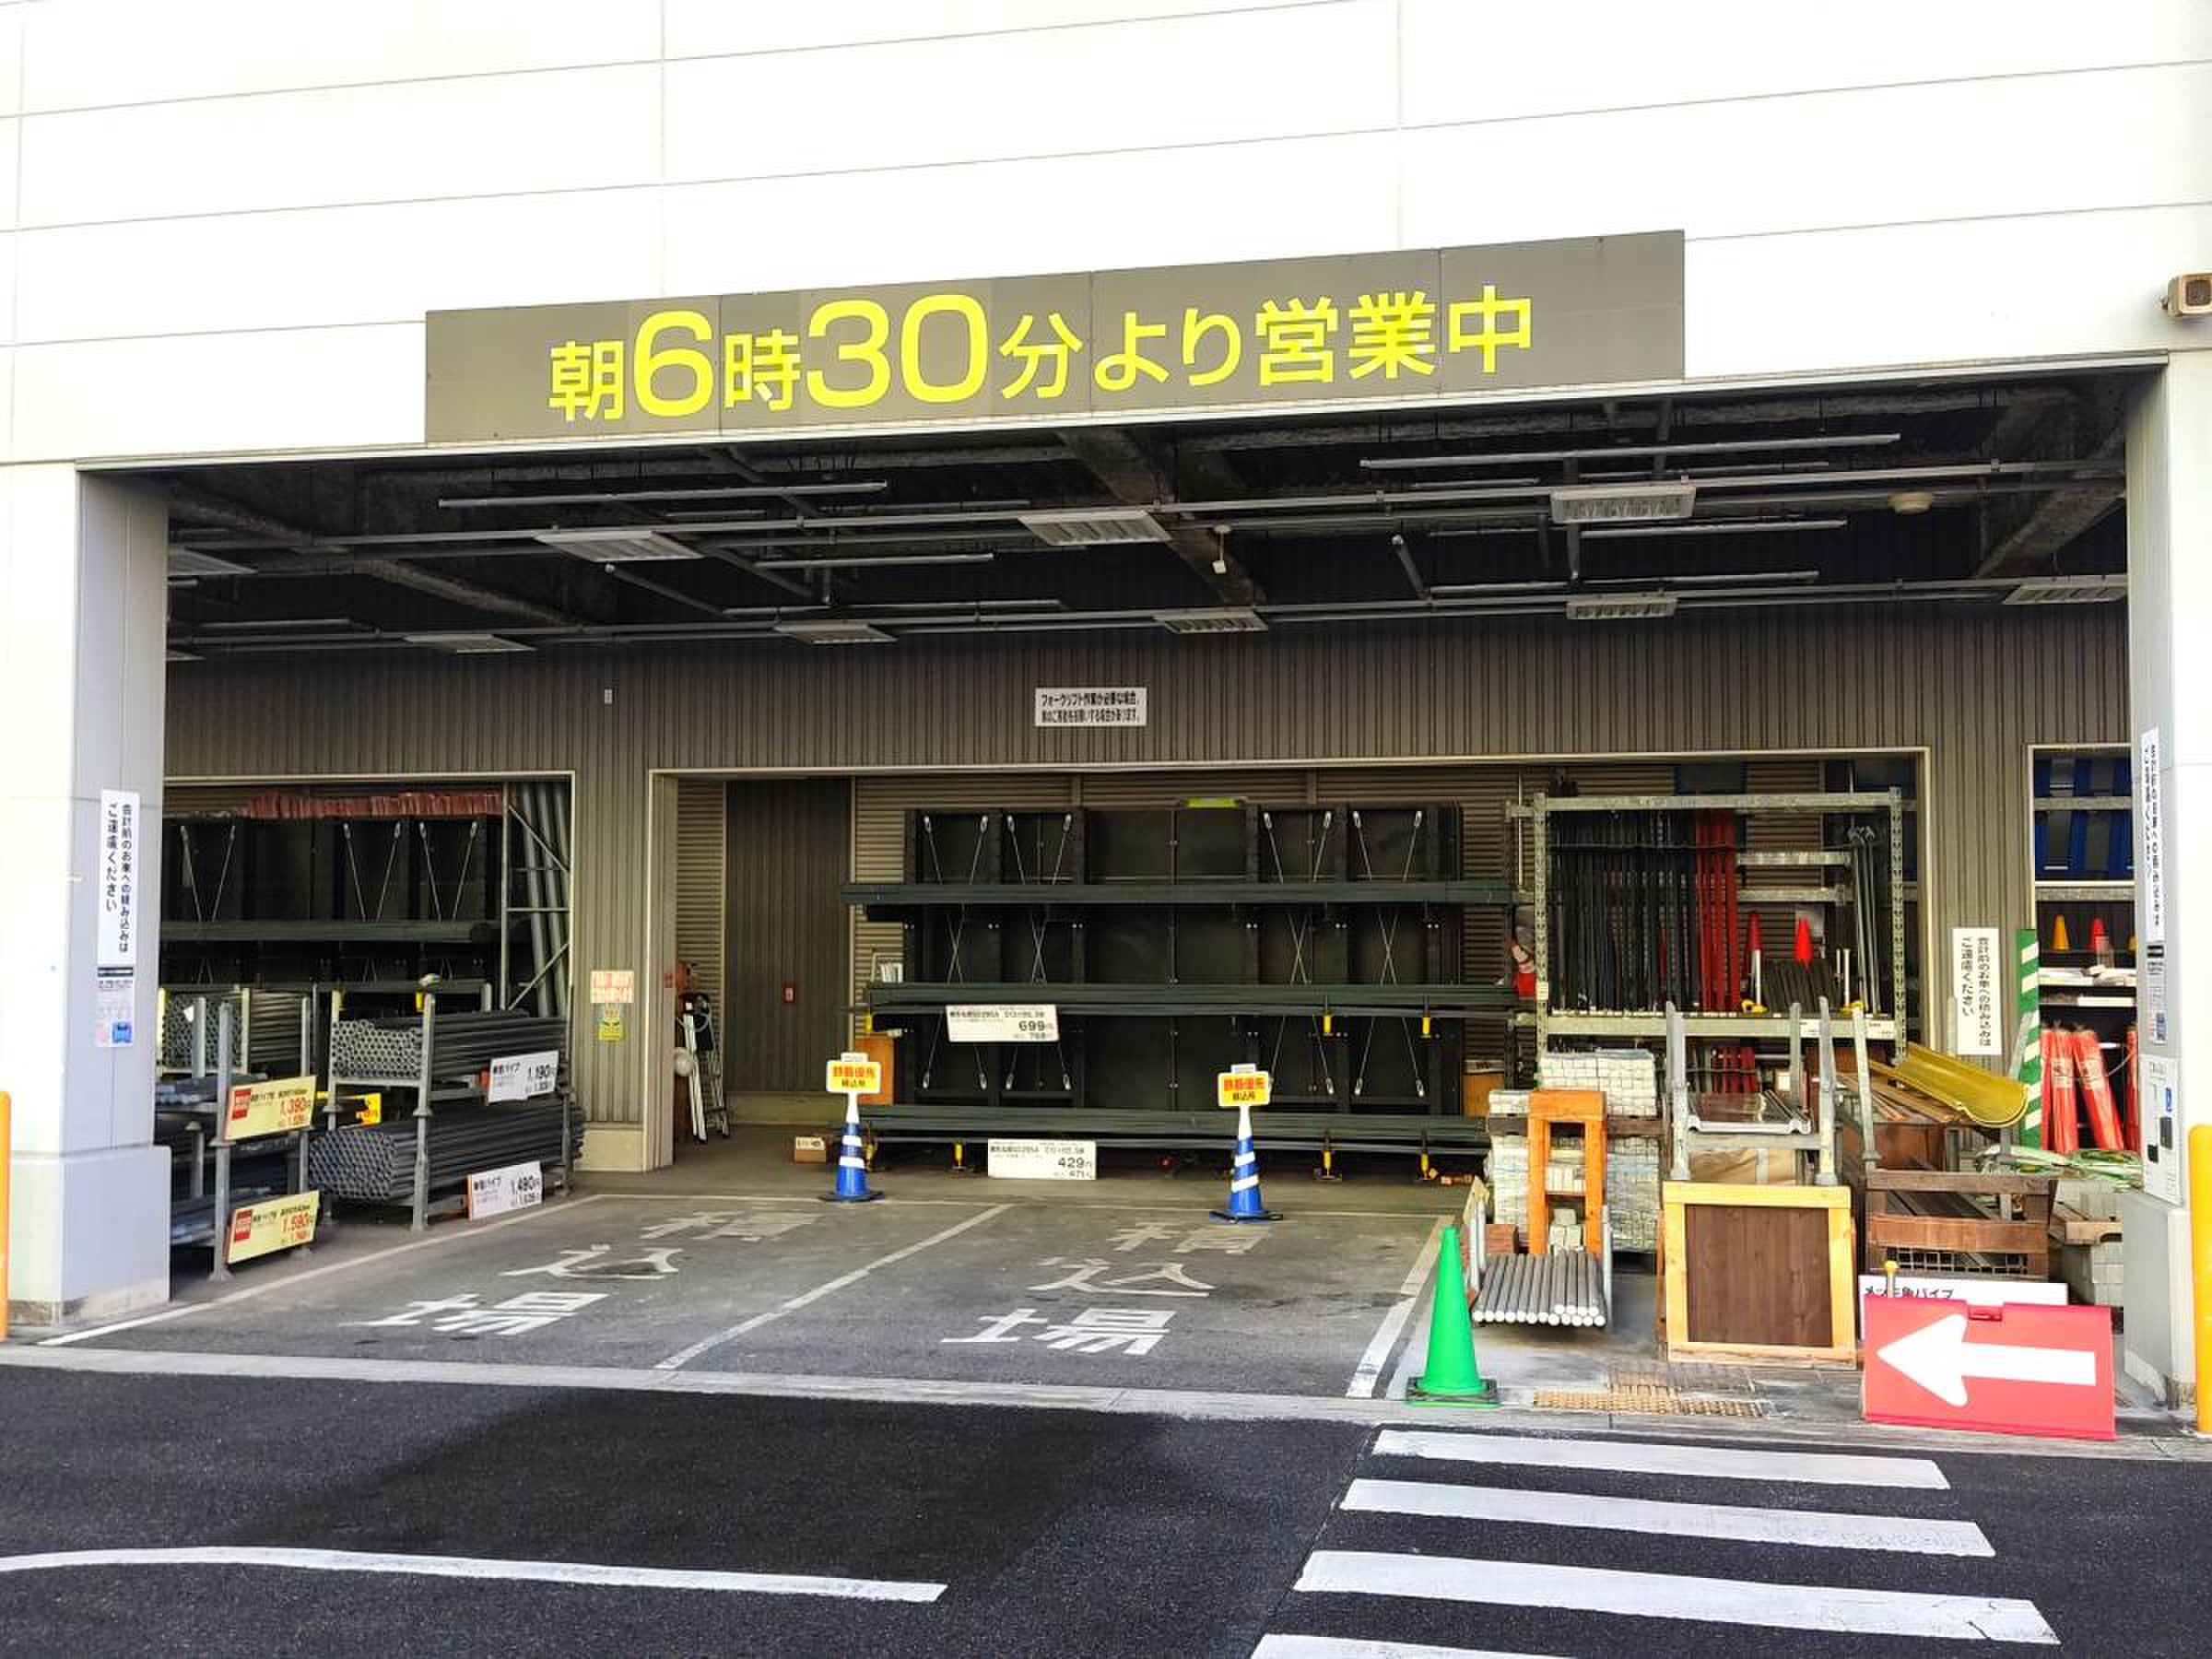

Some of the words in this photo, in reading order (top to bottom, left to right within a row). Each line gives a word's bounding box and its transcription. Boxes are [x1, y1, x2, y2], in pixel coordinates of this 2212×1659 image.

[548, 285, 1533, 421] 朝6時30分より営業中
[105, 803, 118, 912] ご遠慮ください
[120, 804, 132, 953] 会計前のお車への積み込みは
[1960, 936, 1974, 1017] ご遠慮ください
[1977, 936, 1992, 1047] 会計前のお車への積み込みは
